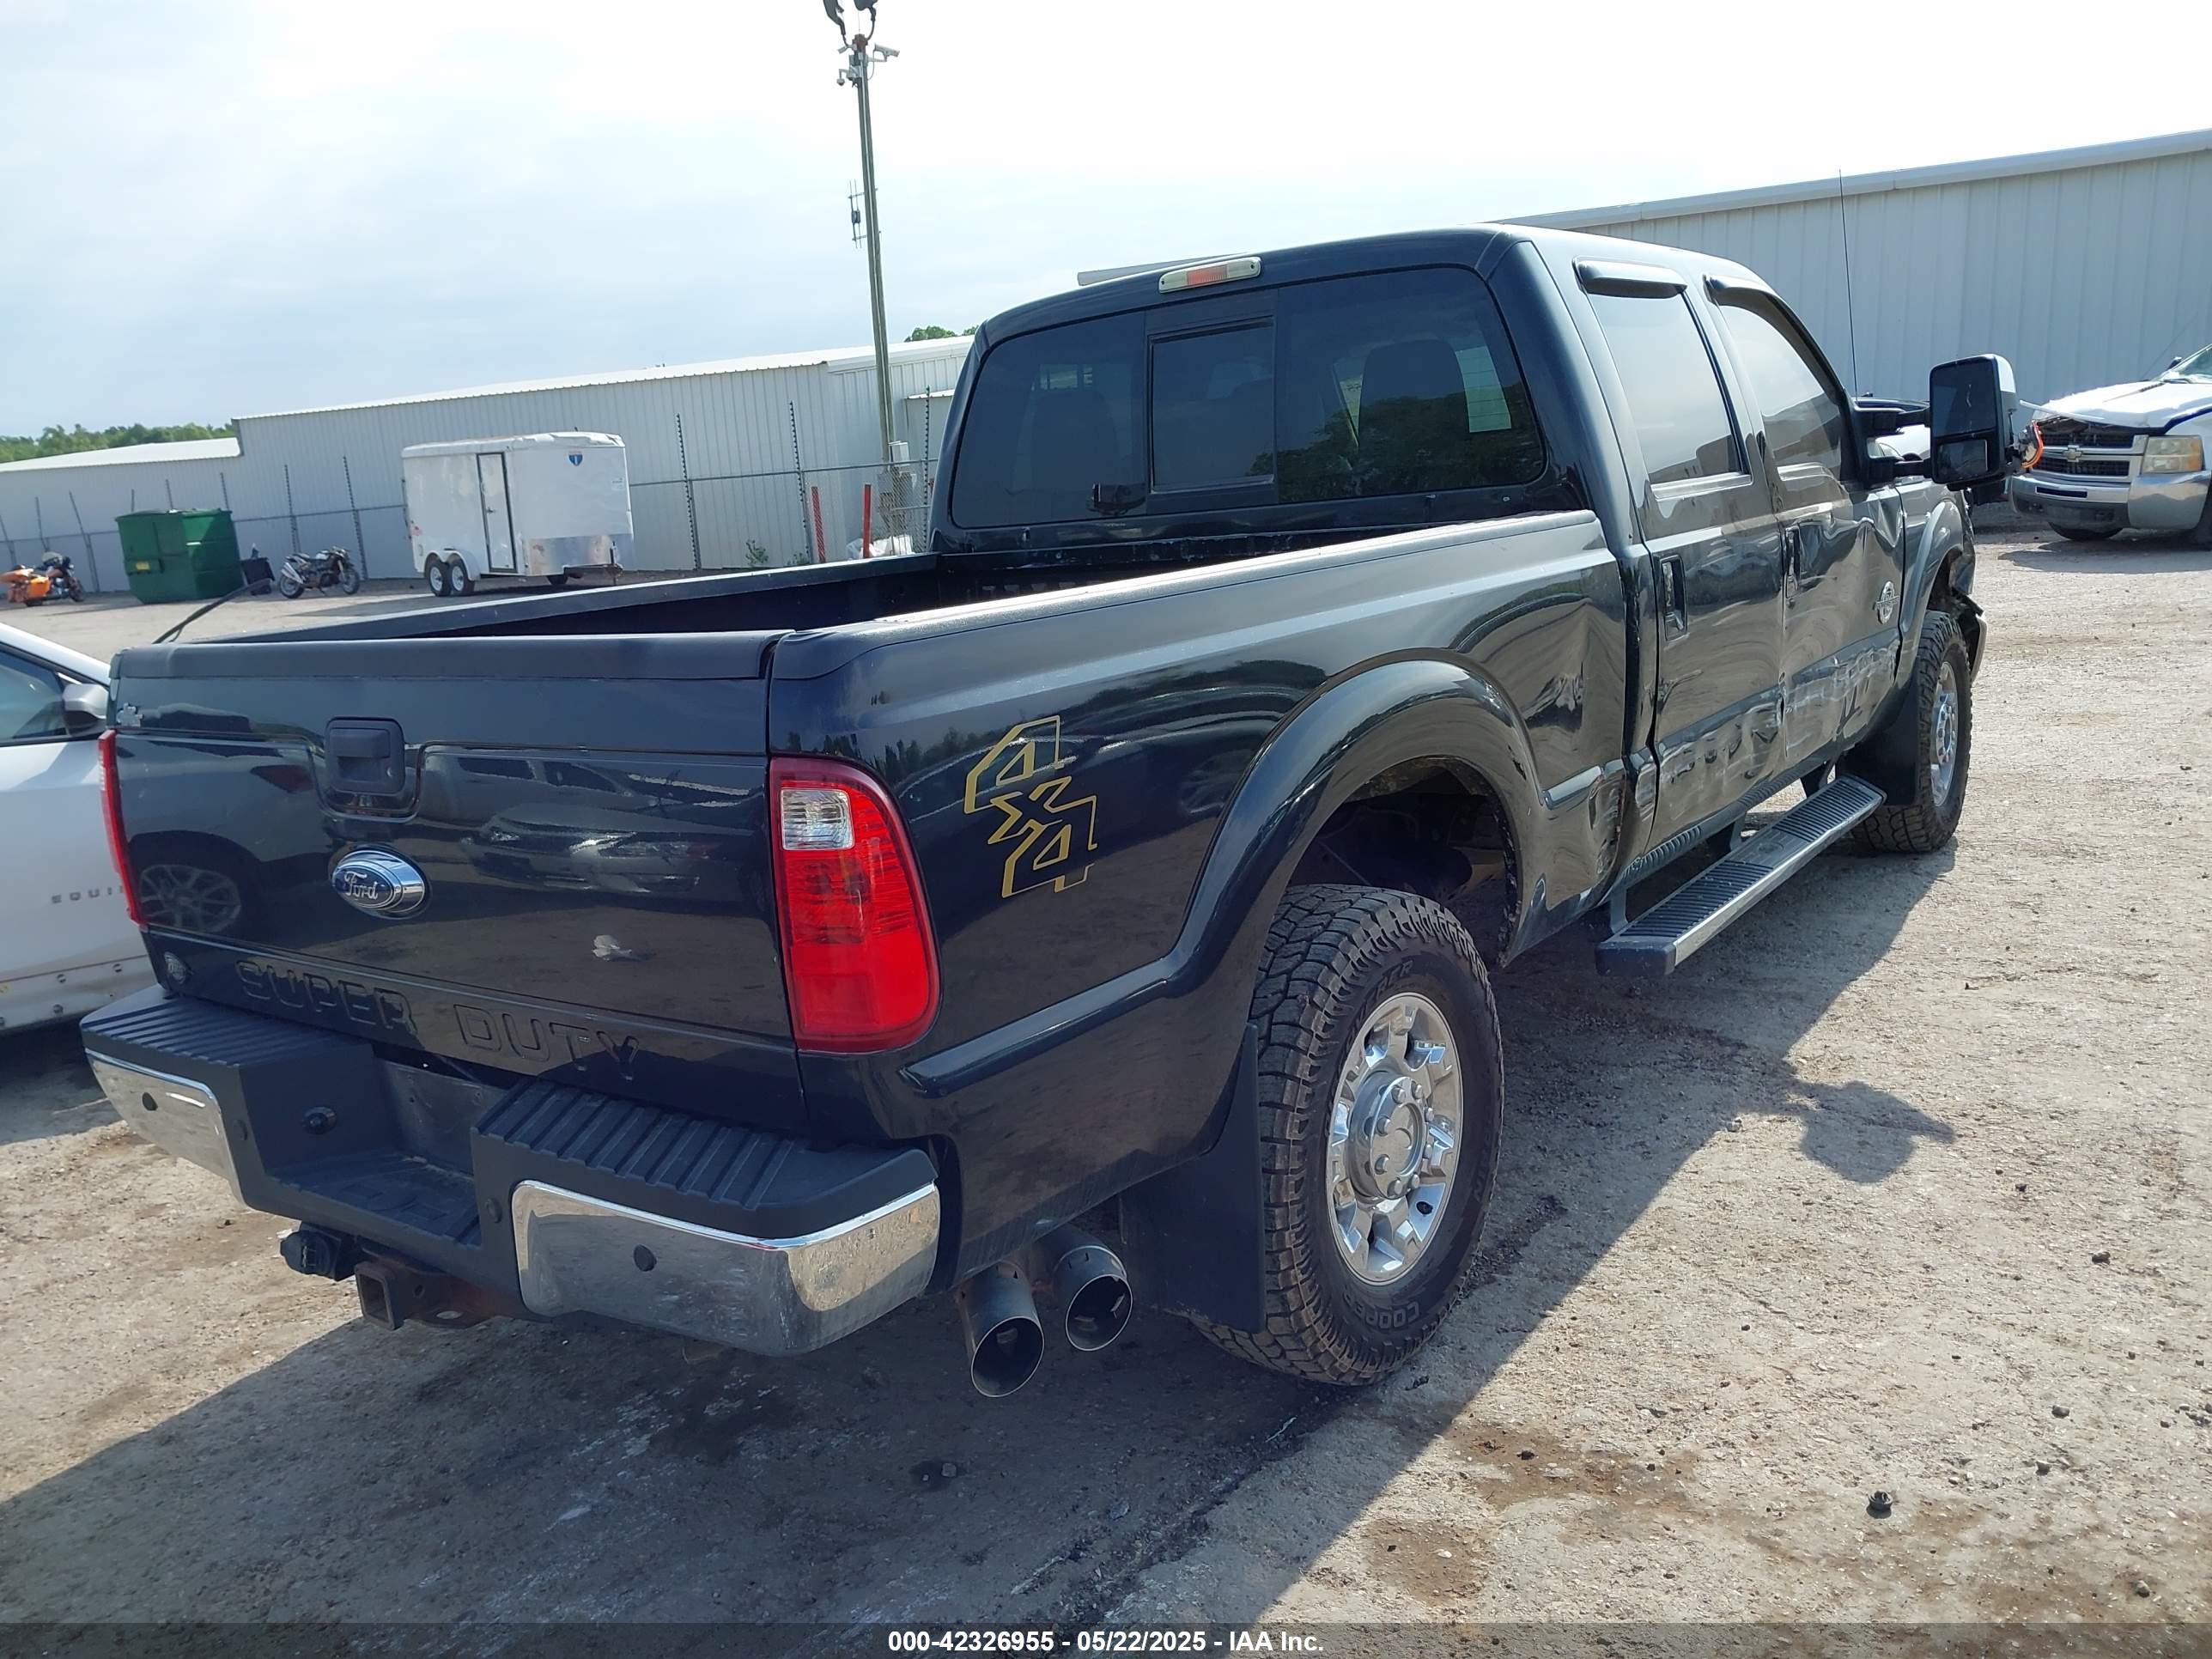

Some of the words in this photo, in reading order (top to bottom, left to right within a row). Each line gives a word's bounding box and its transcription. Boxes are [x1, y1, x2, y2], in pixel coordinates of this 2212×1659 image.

[51, 885, 124, 904] EQUI
[343, 870, 380, 900] Ford
[234, 959, 419, 1035] SUPER
[453, 1003, 641, 1082] DUTY
